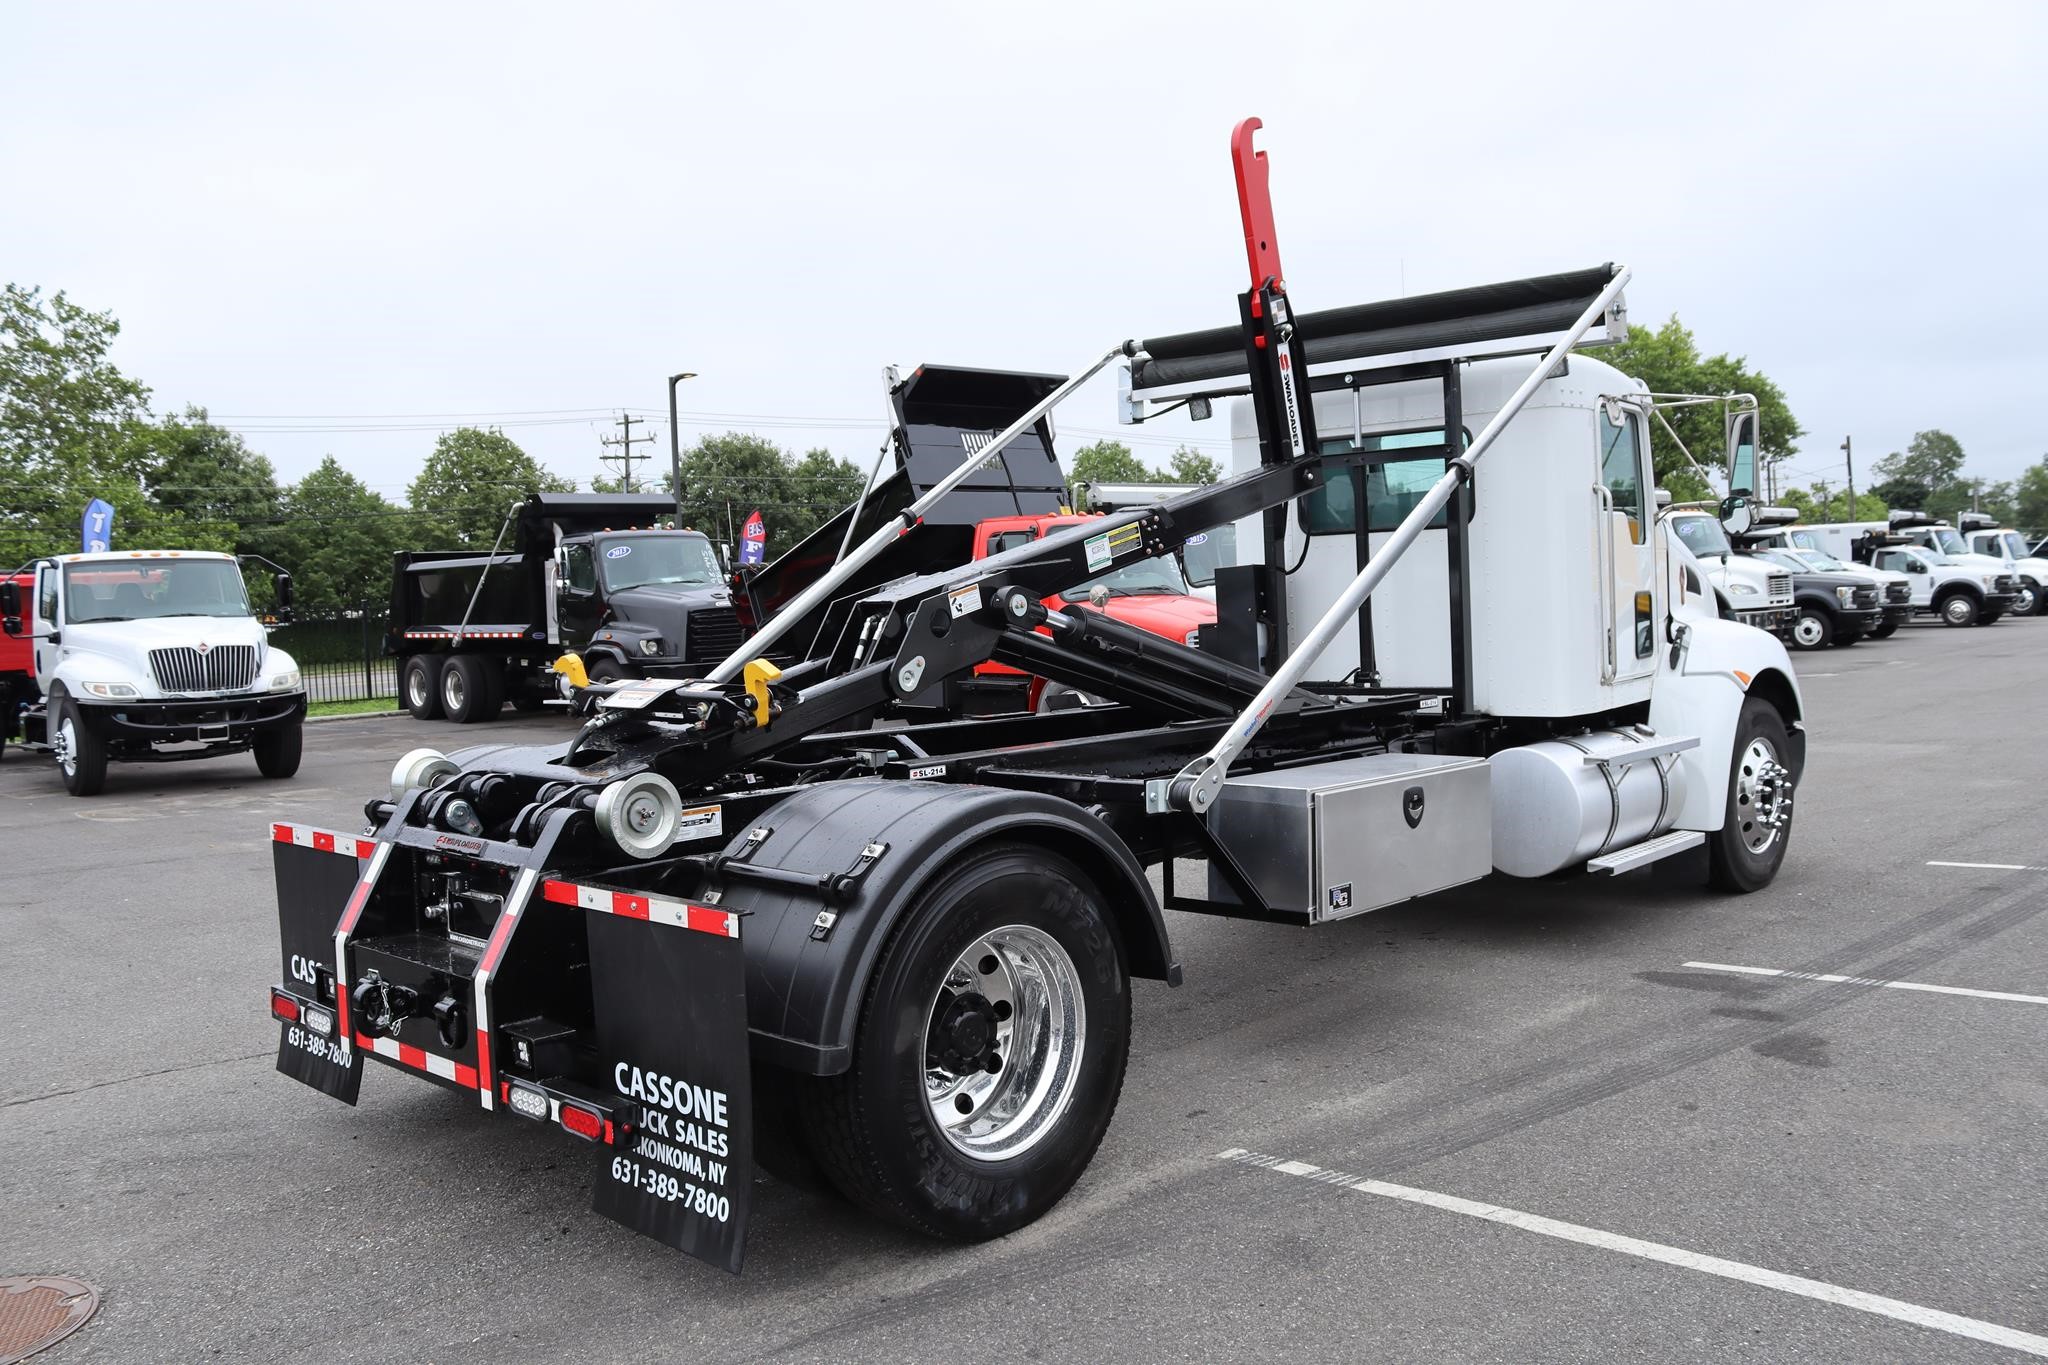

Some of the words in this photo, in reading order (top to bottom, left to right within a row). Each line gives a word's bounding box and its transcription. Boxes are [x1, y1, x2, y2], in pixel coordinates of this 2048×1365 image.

[1283, 373, 1300, 448] SWAPLOADER
[291, 954, 322, 985] CAS
[288, 1026, 352, 1069] 631-389-7800
[614, 1062, 729, 1128] CASSONE
[640, 1107, 669, 1138] UCK
[675, 1119, 729, 1158] SALES
[633, 1136, 706, 1182] KONKOMA,
[708, 1160, 728, 1186] NY
[611, 1156, 730, 1223] 631-389-7800
